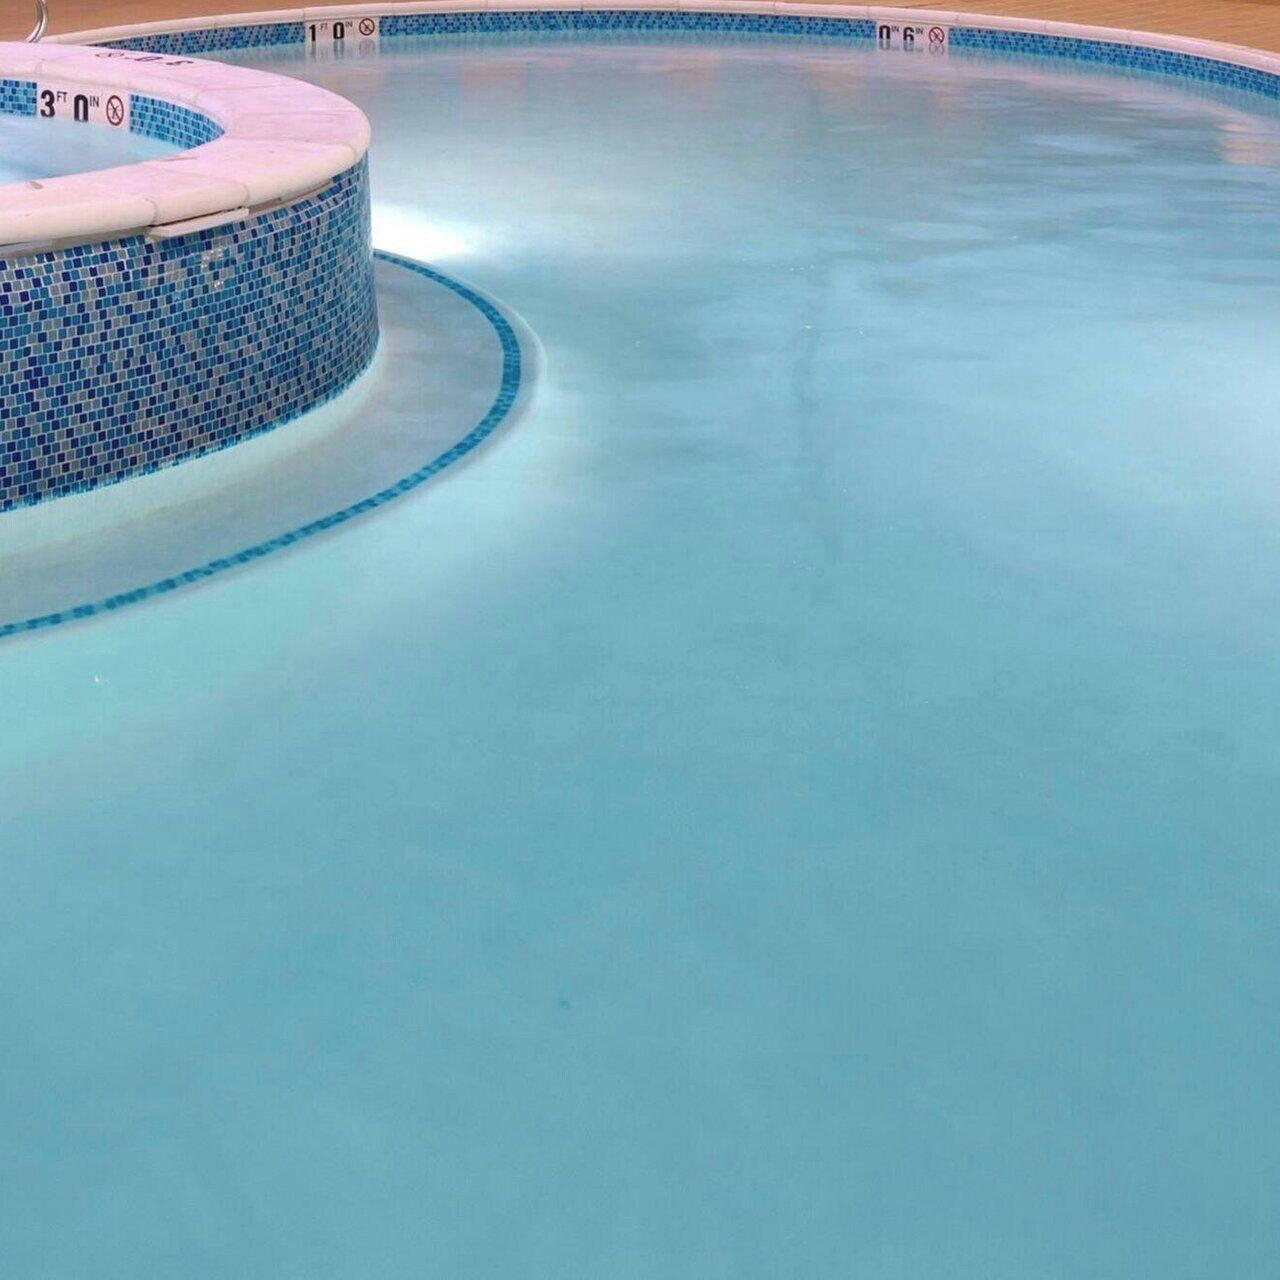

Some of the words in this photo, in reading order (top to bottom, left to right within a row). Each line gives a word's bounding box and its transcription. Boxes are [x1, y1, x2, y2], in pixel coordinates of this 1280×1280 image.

[309, 24, 316, 41] 1
[333, 22, 345, 39] 0
[40, 90, 56, 118] 3
[56, 91, 68, 103] FT
[73, 94, 89, 121] 0
[89, 96, 100, 108] IN
